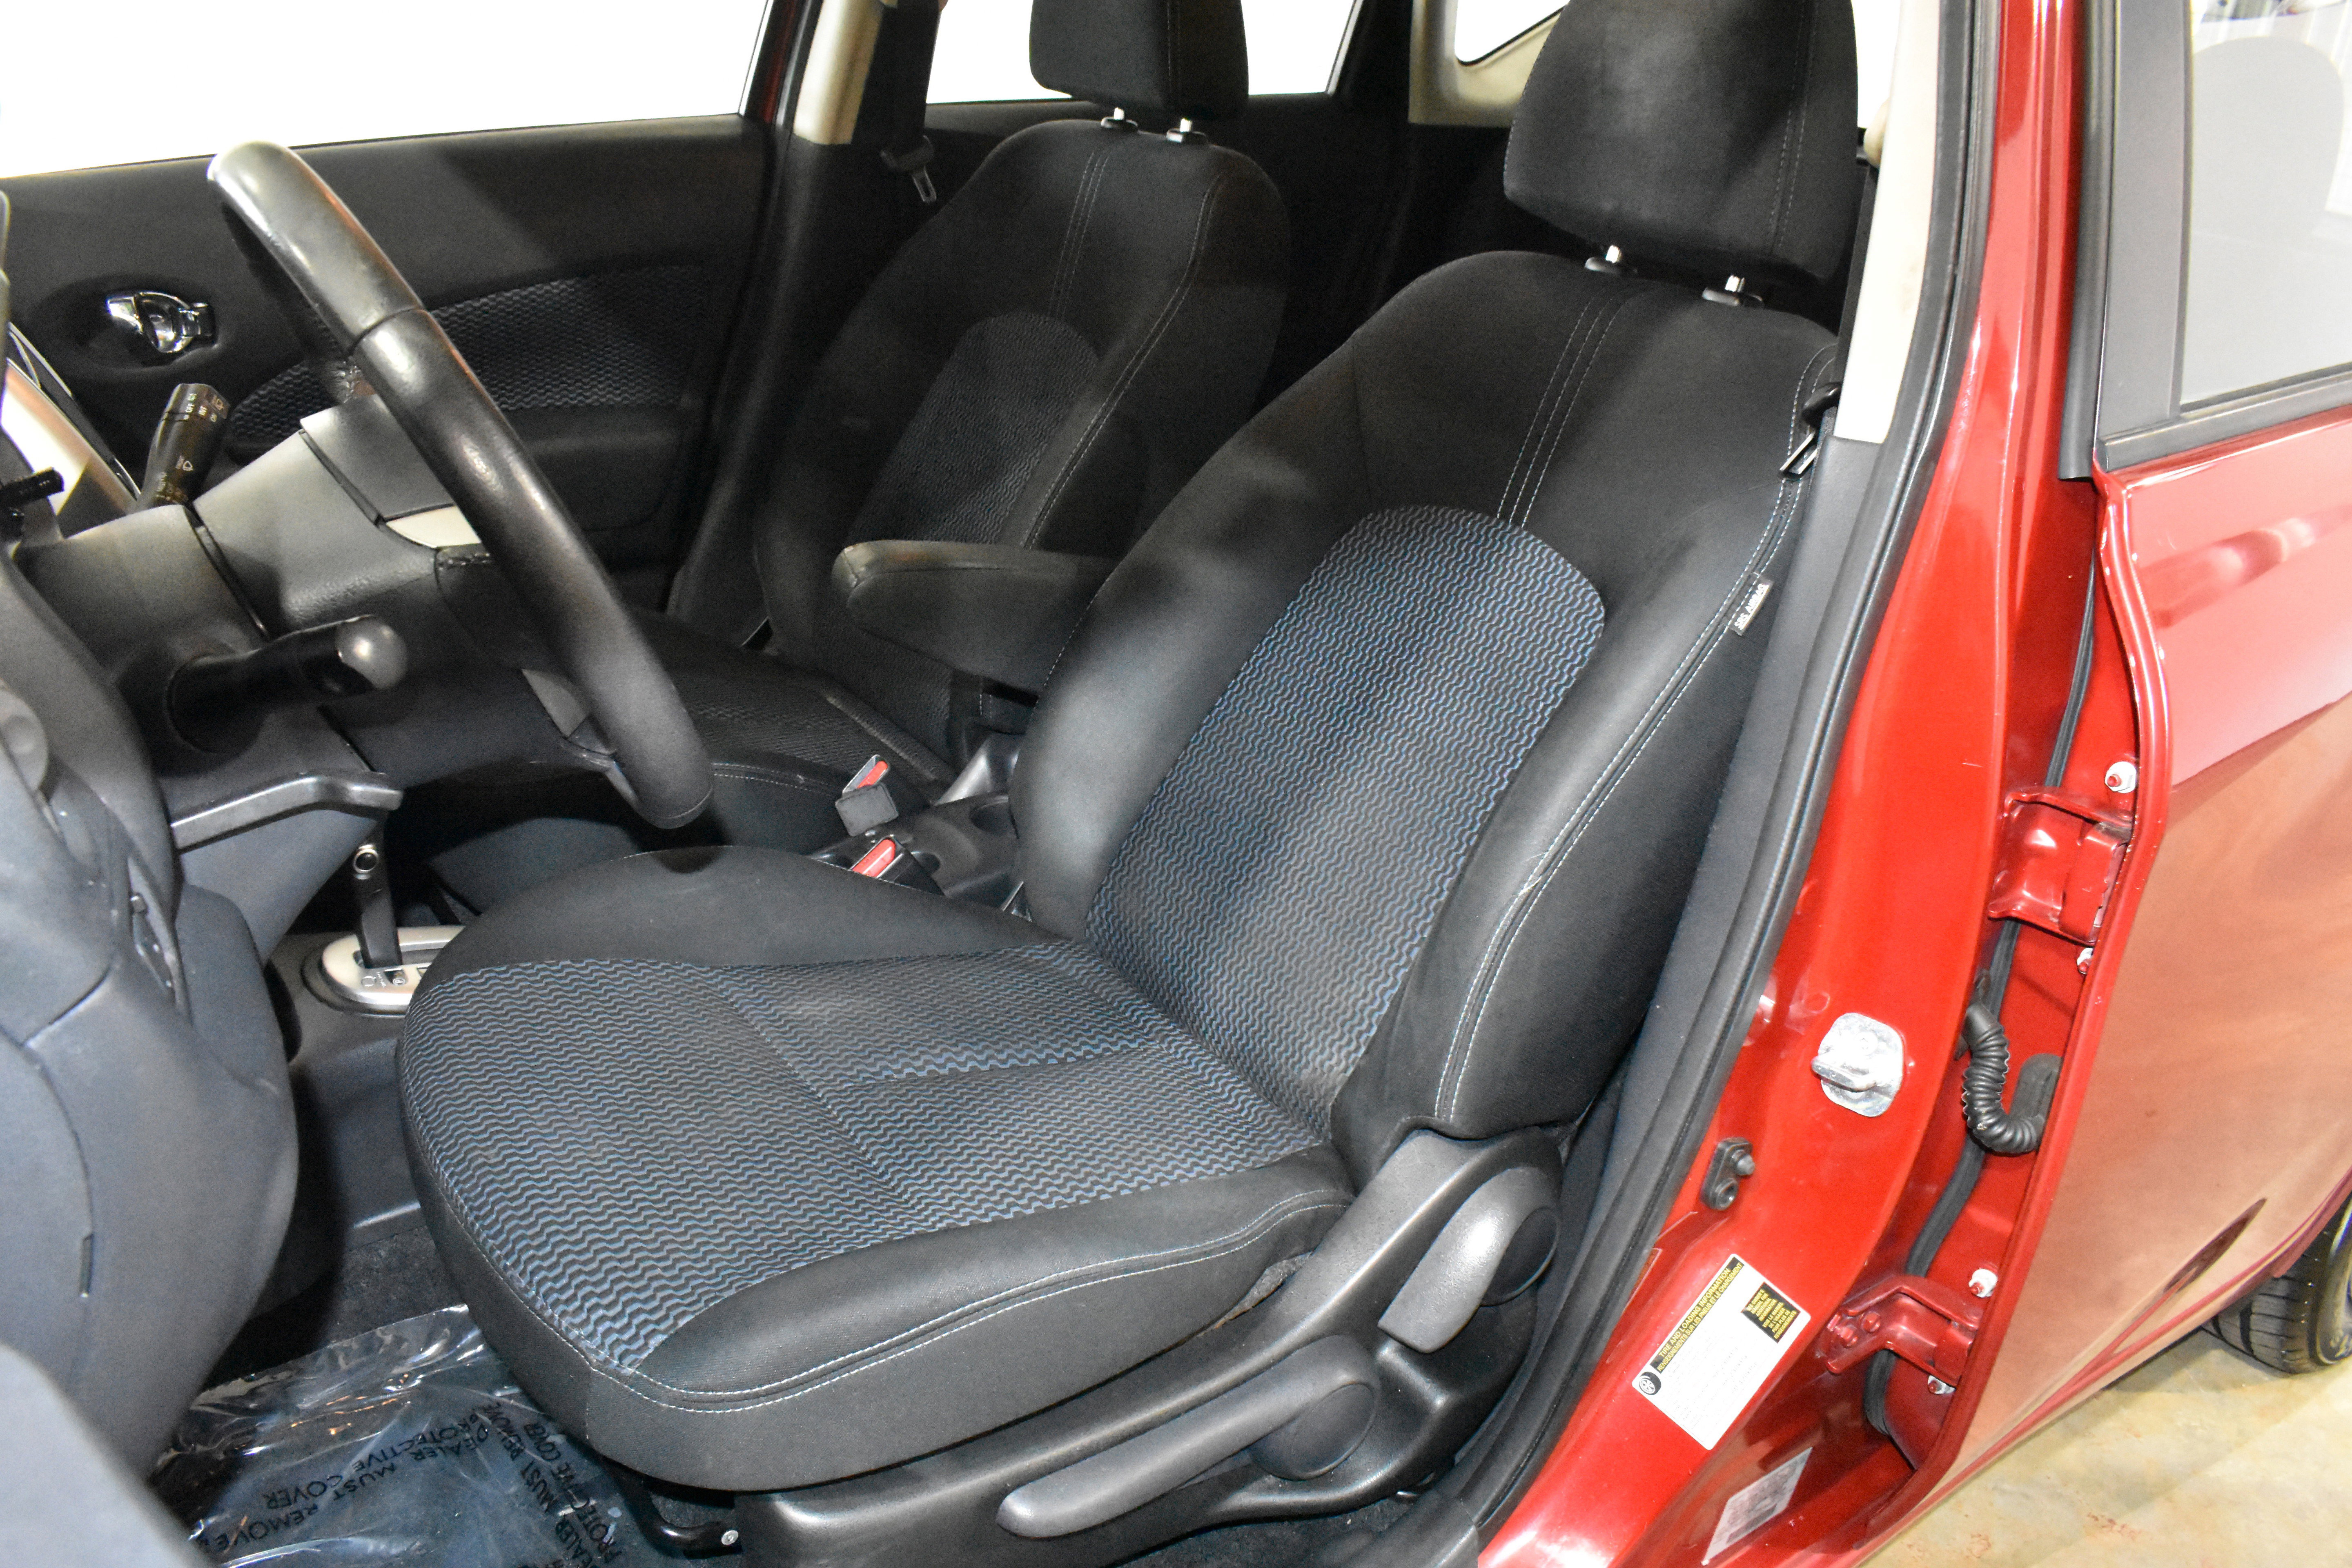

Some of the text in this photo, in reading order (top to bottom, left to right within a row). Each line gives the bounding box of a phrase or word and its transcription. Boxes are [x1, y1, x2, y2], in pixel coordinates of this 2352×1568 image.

[1734, 583, 1767, 629] SRS AIRBAG
[1657, 1262, 1742, 1372] RENSEIGNEMENTS SUR LES PNEUS ET LE CHARGEMENT
[1659, 1343, 1672, 1358] TIRE
[1669, 1330, 1682, 1345] AND
[1679, 1305, 1701, 1332] LOADING
[1698, 1267, 1731, 1307] INFORMATION
[263, 1413, 478, 1510] PROTECTIVE COVER
[524, 1423, 561, 1461] COVER
[214, 1423, 489, 1551] DEALER MUST REMOVE
[521, 1462, 557, 1512] MUST
[555, 1513, 599, 1568] EALER
